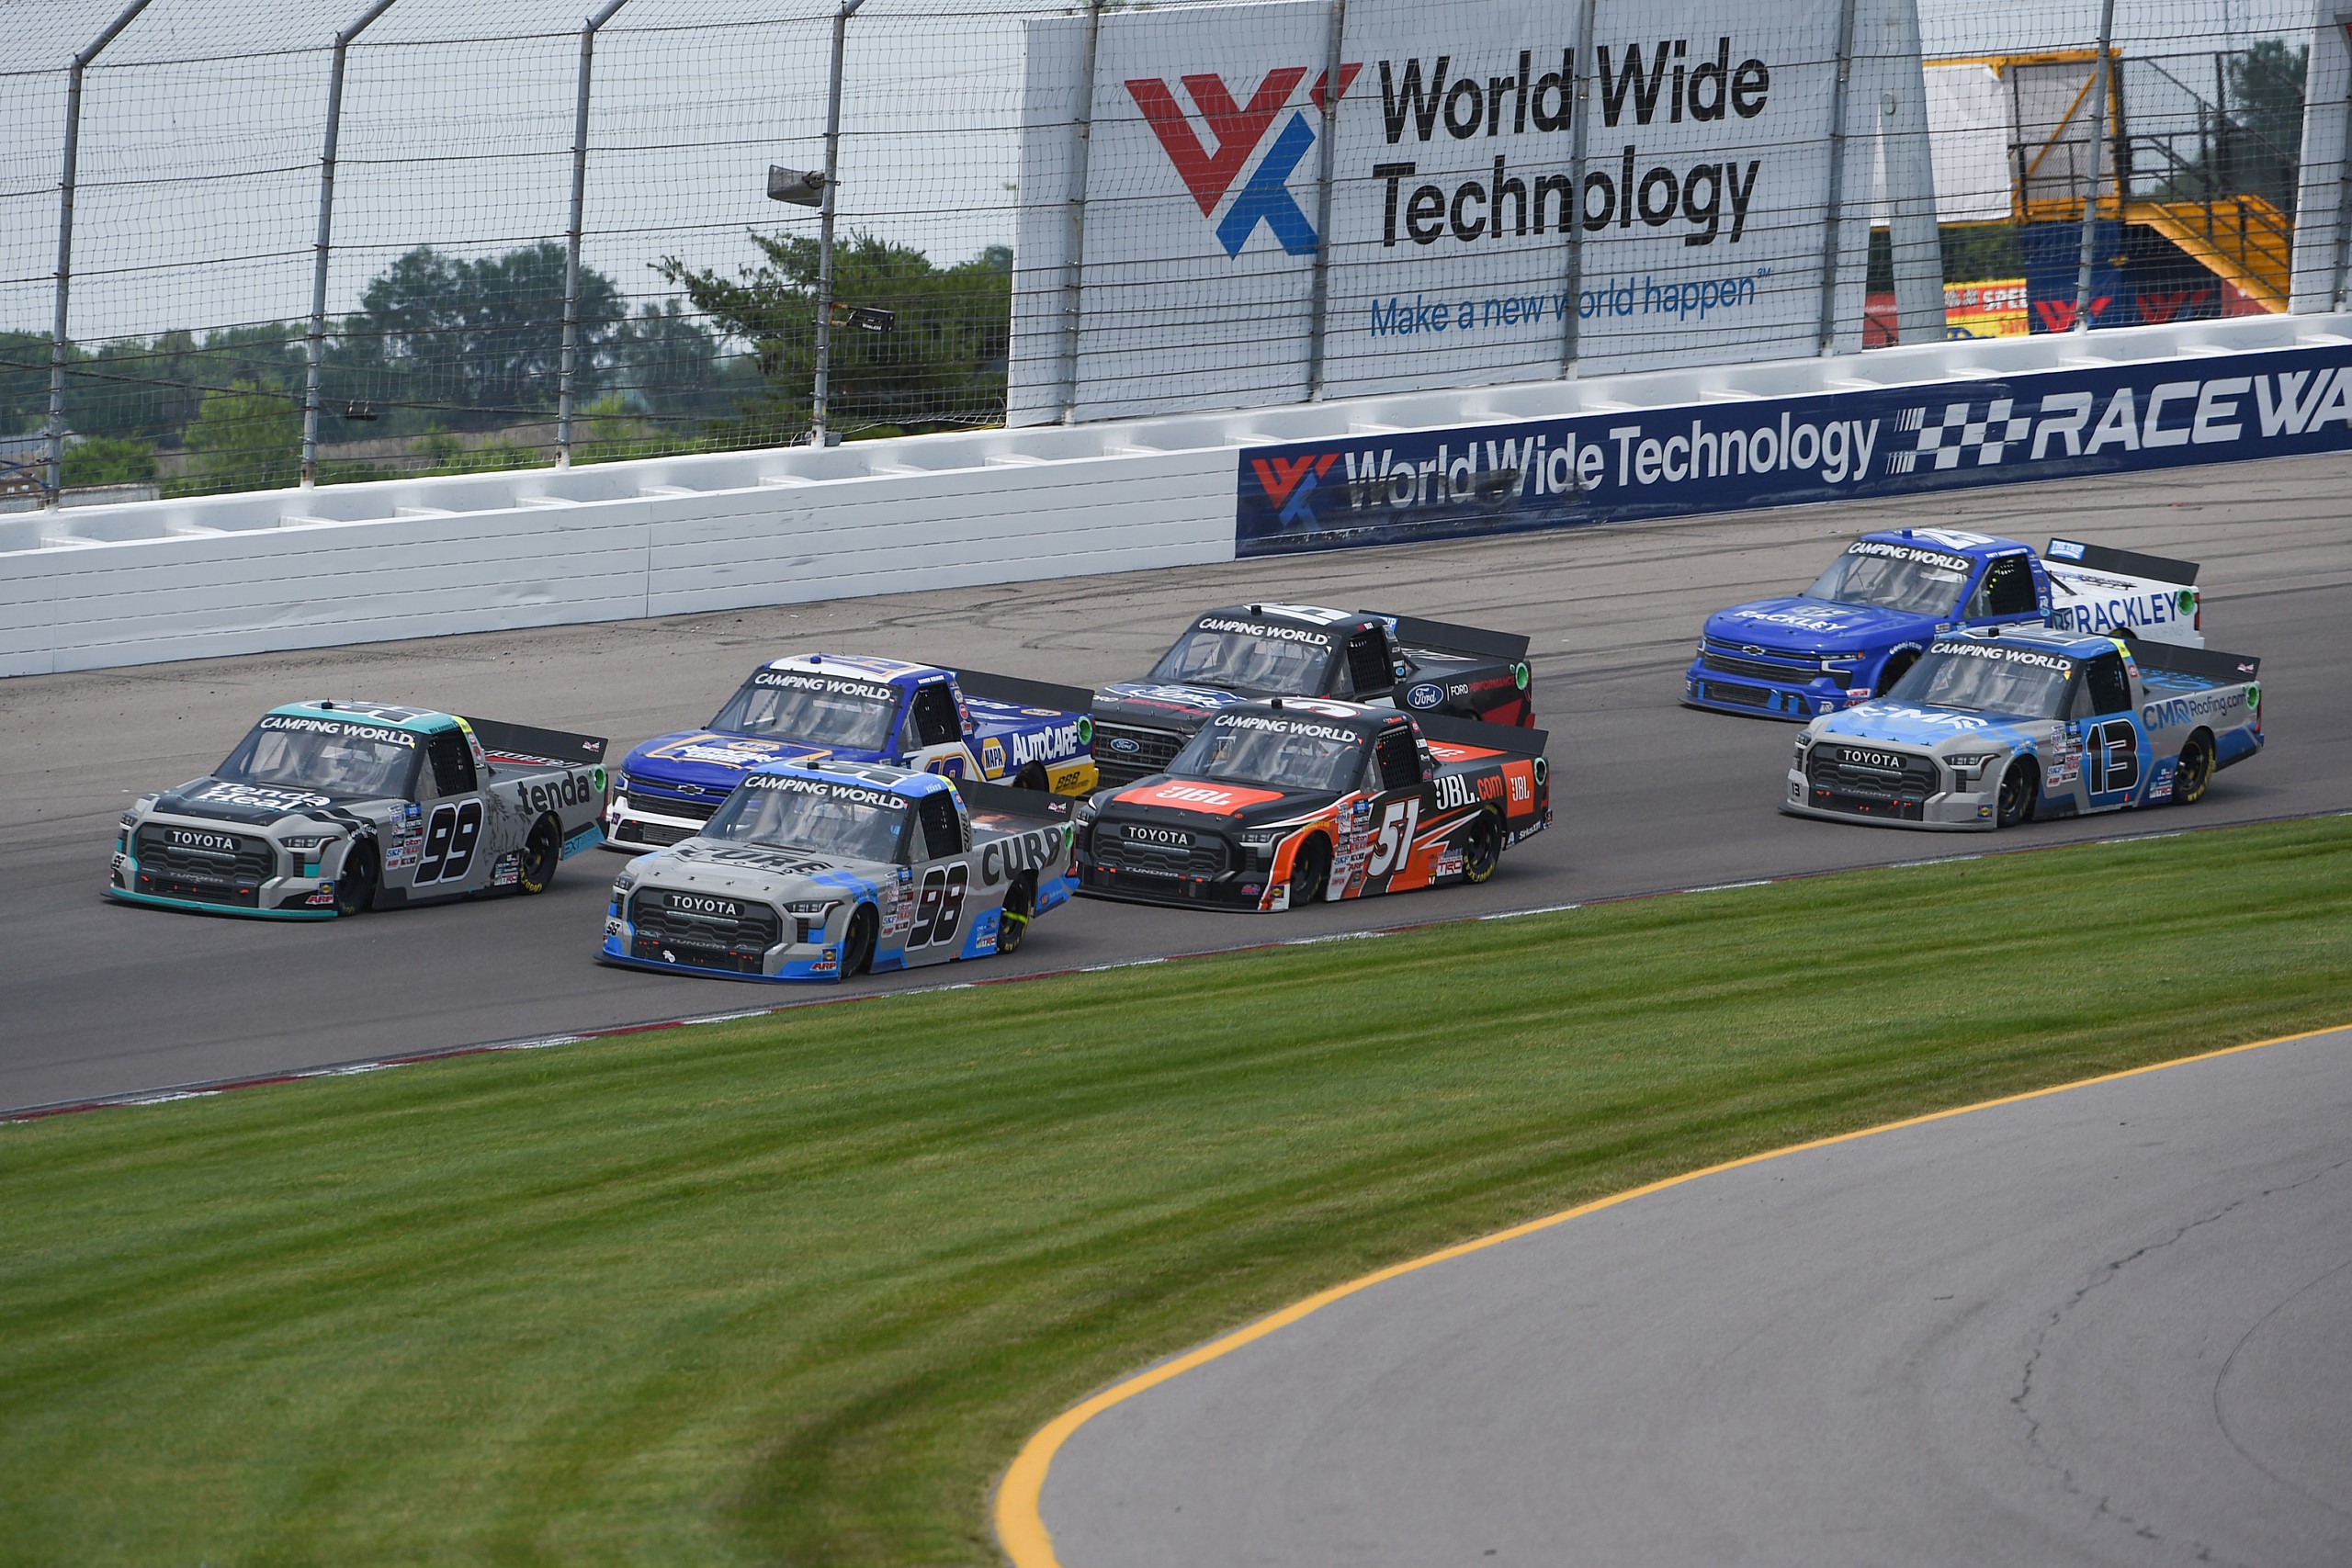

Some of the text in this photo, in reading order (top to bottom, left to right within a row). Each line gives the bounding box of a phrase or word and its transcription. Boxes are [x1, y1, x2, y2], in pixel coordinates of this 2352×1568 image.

[1378, 37, 1770, 144] World Wide
[1372, 144, 1761, 247] Technology
[1371, 294, 1450, 337] Make
[1458, 305, 1474, 330] a
[1484, 295, 1544, 328] new
[1645, 275, 1755, 321] happen
[1345, 440, 1477, 513] World
[1487, 432, 1604, 498] Wide
[1609, 411, 1881, 488] Technology
[1848, 542, 1969, 572] CAMPING WORLD
[1733, 610, 1849, 632] RACKLEY
[2075, 591, 2178, 633] RACKLEY
[1198, 617, 1329, 646] CAMPING WORLD
[2143, 624, 2184, 641] ROOFING
[1930, 642, 2071, 671] CAMPING WORLD
[754, 671, 892, 701] CAMPING WORLD
[1413, 687, 1437, 705] Ford
[1451, 675, 1516, 696] FORD PERFORMANCE
[2190, 692, 2246, 717] Roofing.com
[260, 716, 341, 735] CAMPING
[343, 725, 414, 746] WORLD
[1214, 715, 1357, 743] CAMPING WORLD
[984, 747, 1003, 769] NAPA
[1012, 725, 1079, 766] AUTOCARE
[1115, 739, 1134, 750] Ford
[2085, 717, 2140, 796] 13
[1843, 750, 1900, 768] TOYOTA
[517, 769, 591, 815] tenda
[744, 775, 905, 810] CAMPING WORLD
[1056, 771, 1080, 790] BBB
[1433, 773, 1504, 811] JBL.com
[1510, 775, 1530, 802] JBL
[1792, 782, 1801, 797] 13
[197, 791, 305, 811] Heal
[209, 782, 331, 807] Tenda
[1155, 785, 1233, 806] JBL
[172, 830, 234, 850] TOYOTA
[412, 797, 484, 888] 99
[1128, 826, 1188, 845] TOYOTA
[1367, 798, 1420, 877] 51
[981, 827, 1062, 886] CURB
[1125, 866, 1179, 878] TUNDRA
[306, 895, 334, 905] ARP
[672, 895, 737, 916] TOYOTA
[904, 860, 970, 953] 98
[668, 937, 728, 950] TUNDRA
[810, 961, 837, 971] ARP
